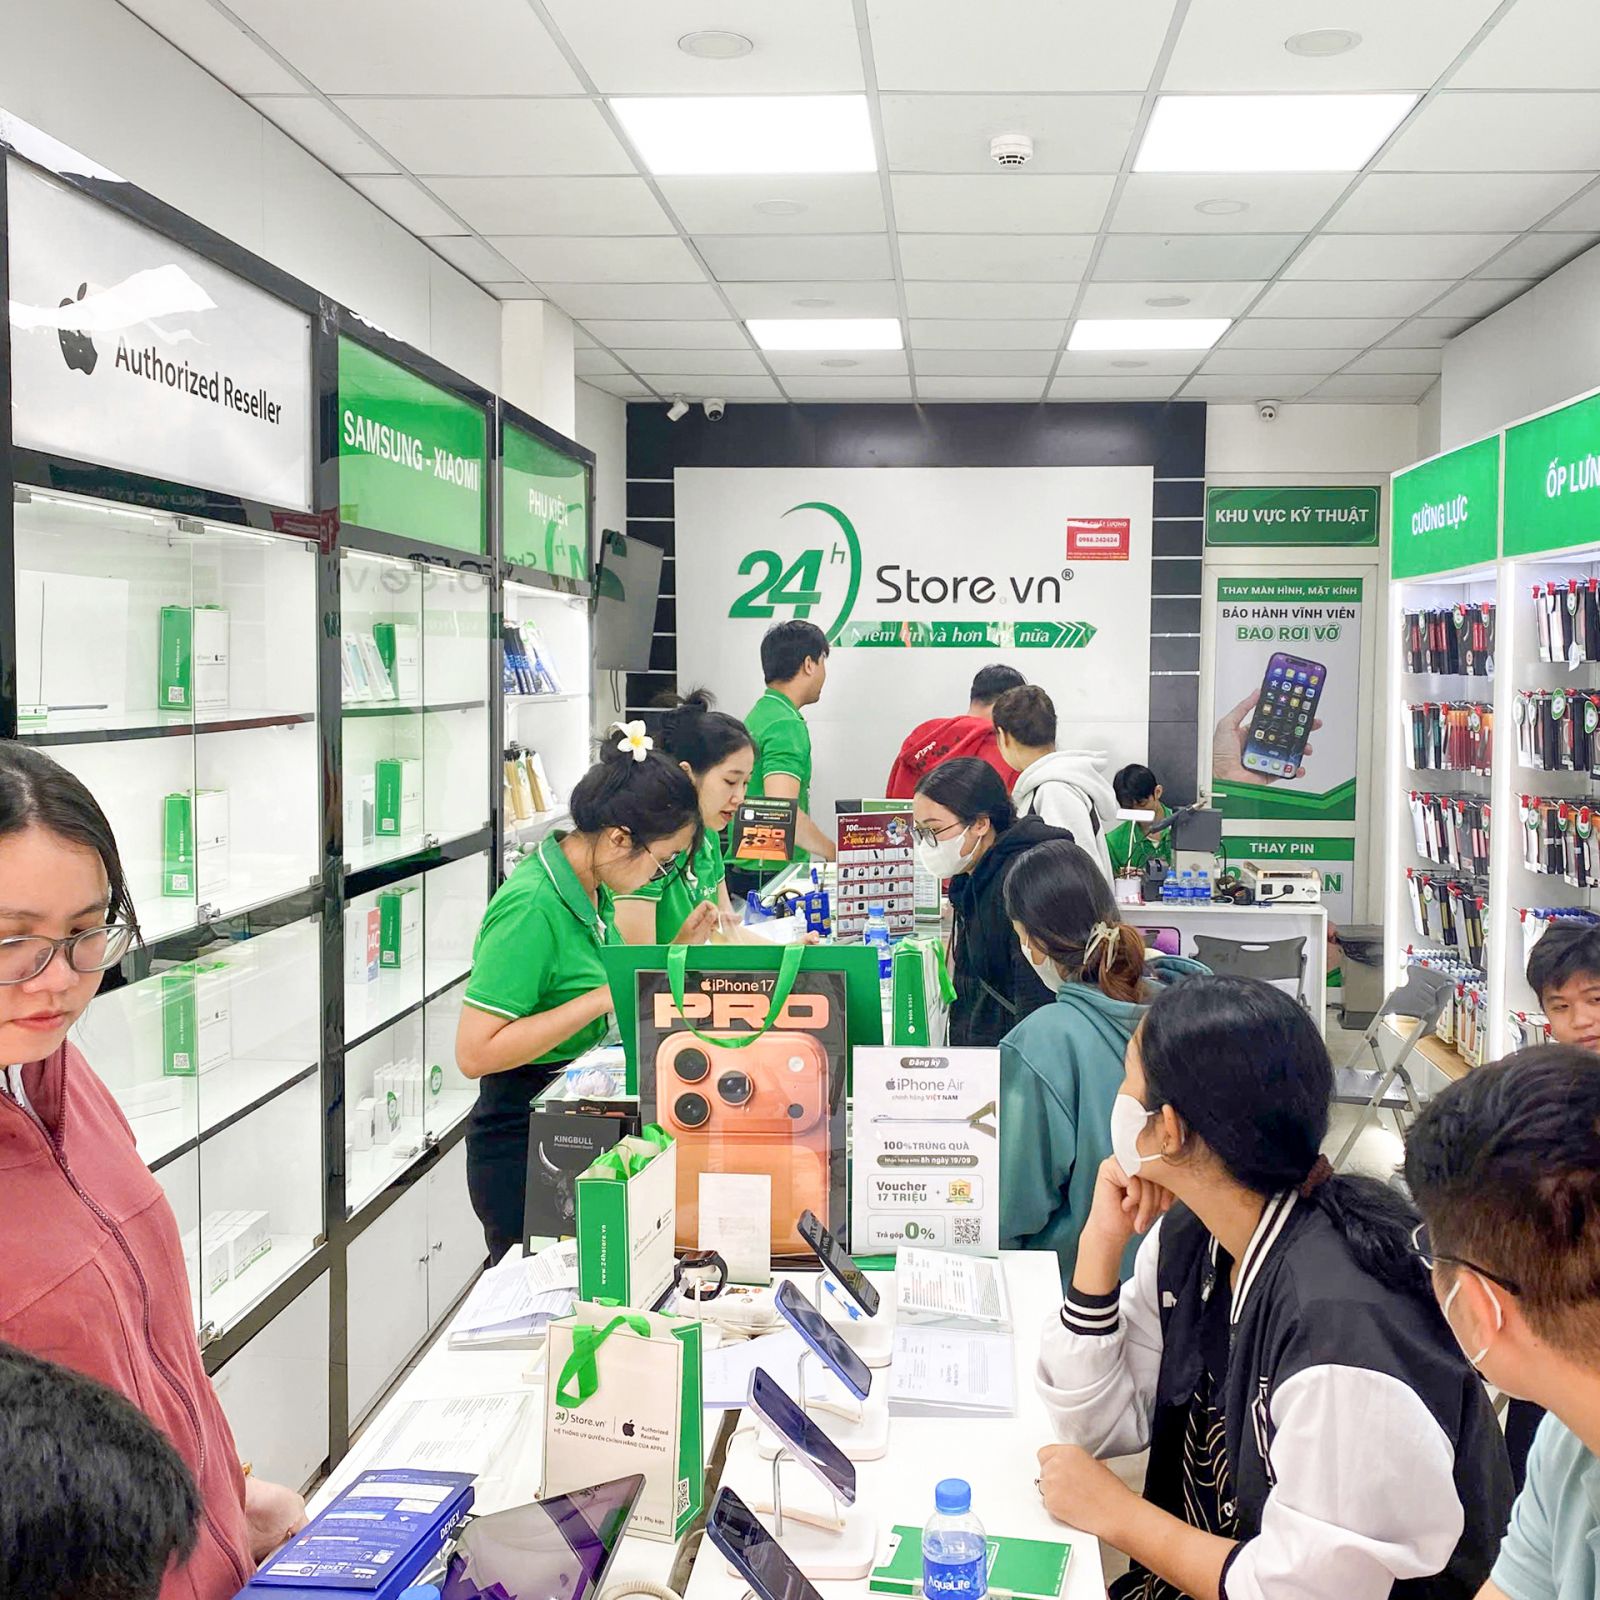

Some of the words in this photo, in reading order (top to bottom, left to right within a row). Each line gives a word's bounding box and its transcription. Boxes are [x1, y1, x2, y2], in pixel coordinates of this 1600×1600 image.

[116, 339, 219, 403] Authorized
[224, 376, 282, 425] Reseller
[344, 410, 423, 471] SAMSUNG
[434, 446, 478, 492] XIAOMI
[1545, 456, 1568, 499] ỐP
[529, 488, 547, 525] PHỤ
[1215, 509, 1248, 523] KHU
[1252, 508, 1287, 526] VỰC
[1290, 506, 1312, 523] KỸ
[1315, 506, 1369, 526] THUẬT
[1411, 502, 1445, 536] CƯỜNG
[1446, 493, 1468, 530] LỰC
[1222, 587, 1249, 595] THAY
[1251, 586, 1275, 595] MÀN
[1277, 585, 1306, 596] HÌNH,
[1308, 586, 1330, 597] MẶT
[1332, 585, 1358, 595] KÍNH
[1222, 606, 1248, 619] BẢO
[1252, 607, 1288, 619] HÀNH
[1292, 607, 1322, 619] VĨNH
[1326, 606, 1356, 619] VIỄN
[930, 626, 947, 642] và
[952, 626, 982, 642] hơn
[1020, 628, 1050, 643] nữa
[1237, 626, 1274, 640] BAO
[1279, 625, 1309, 640] RƠI
[1315, 624, 1340, 640] VỠ
[1249, 842, 1286, 854] THAY
[1290, 843, 1315, 854] PIN
[711, 979, 759, 992] iPhone
[760, 979, 776, 992] 17
[653, 992, 830, 1030] PRO
[897, 1078, 945, 1091] iPhone
[947, 1078, 964, 1091] Air
[925, 1094, 941, 1102] VIỆT
[554, 1135, 594, 1145] KINGBULL
[948, 1140, 970, 1152] QUÀ
[876, 1181, 927, 1191] Voucher
[877, 1193, 889, 1202] 17
[893, 1191, 927, 1204] TRIỆU
[876, 1231, 889, 1239] Trả
[889, 1231, 904, 1240] góp
[905, 1221, 935, 1240] 0%
[570, 1413, 605, 1428] Store.vn
[640, 1433, 661, 1442] Reseller
[928, 1575, 971, 1592] AquaLife
